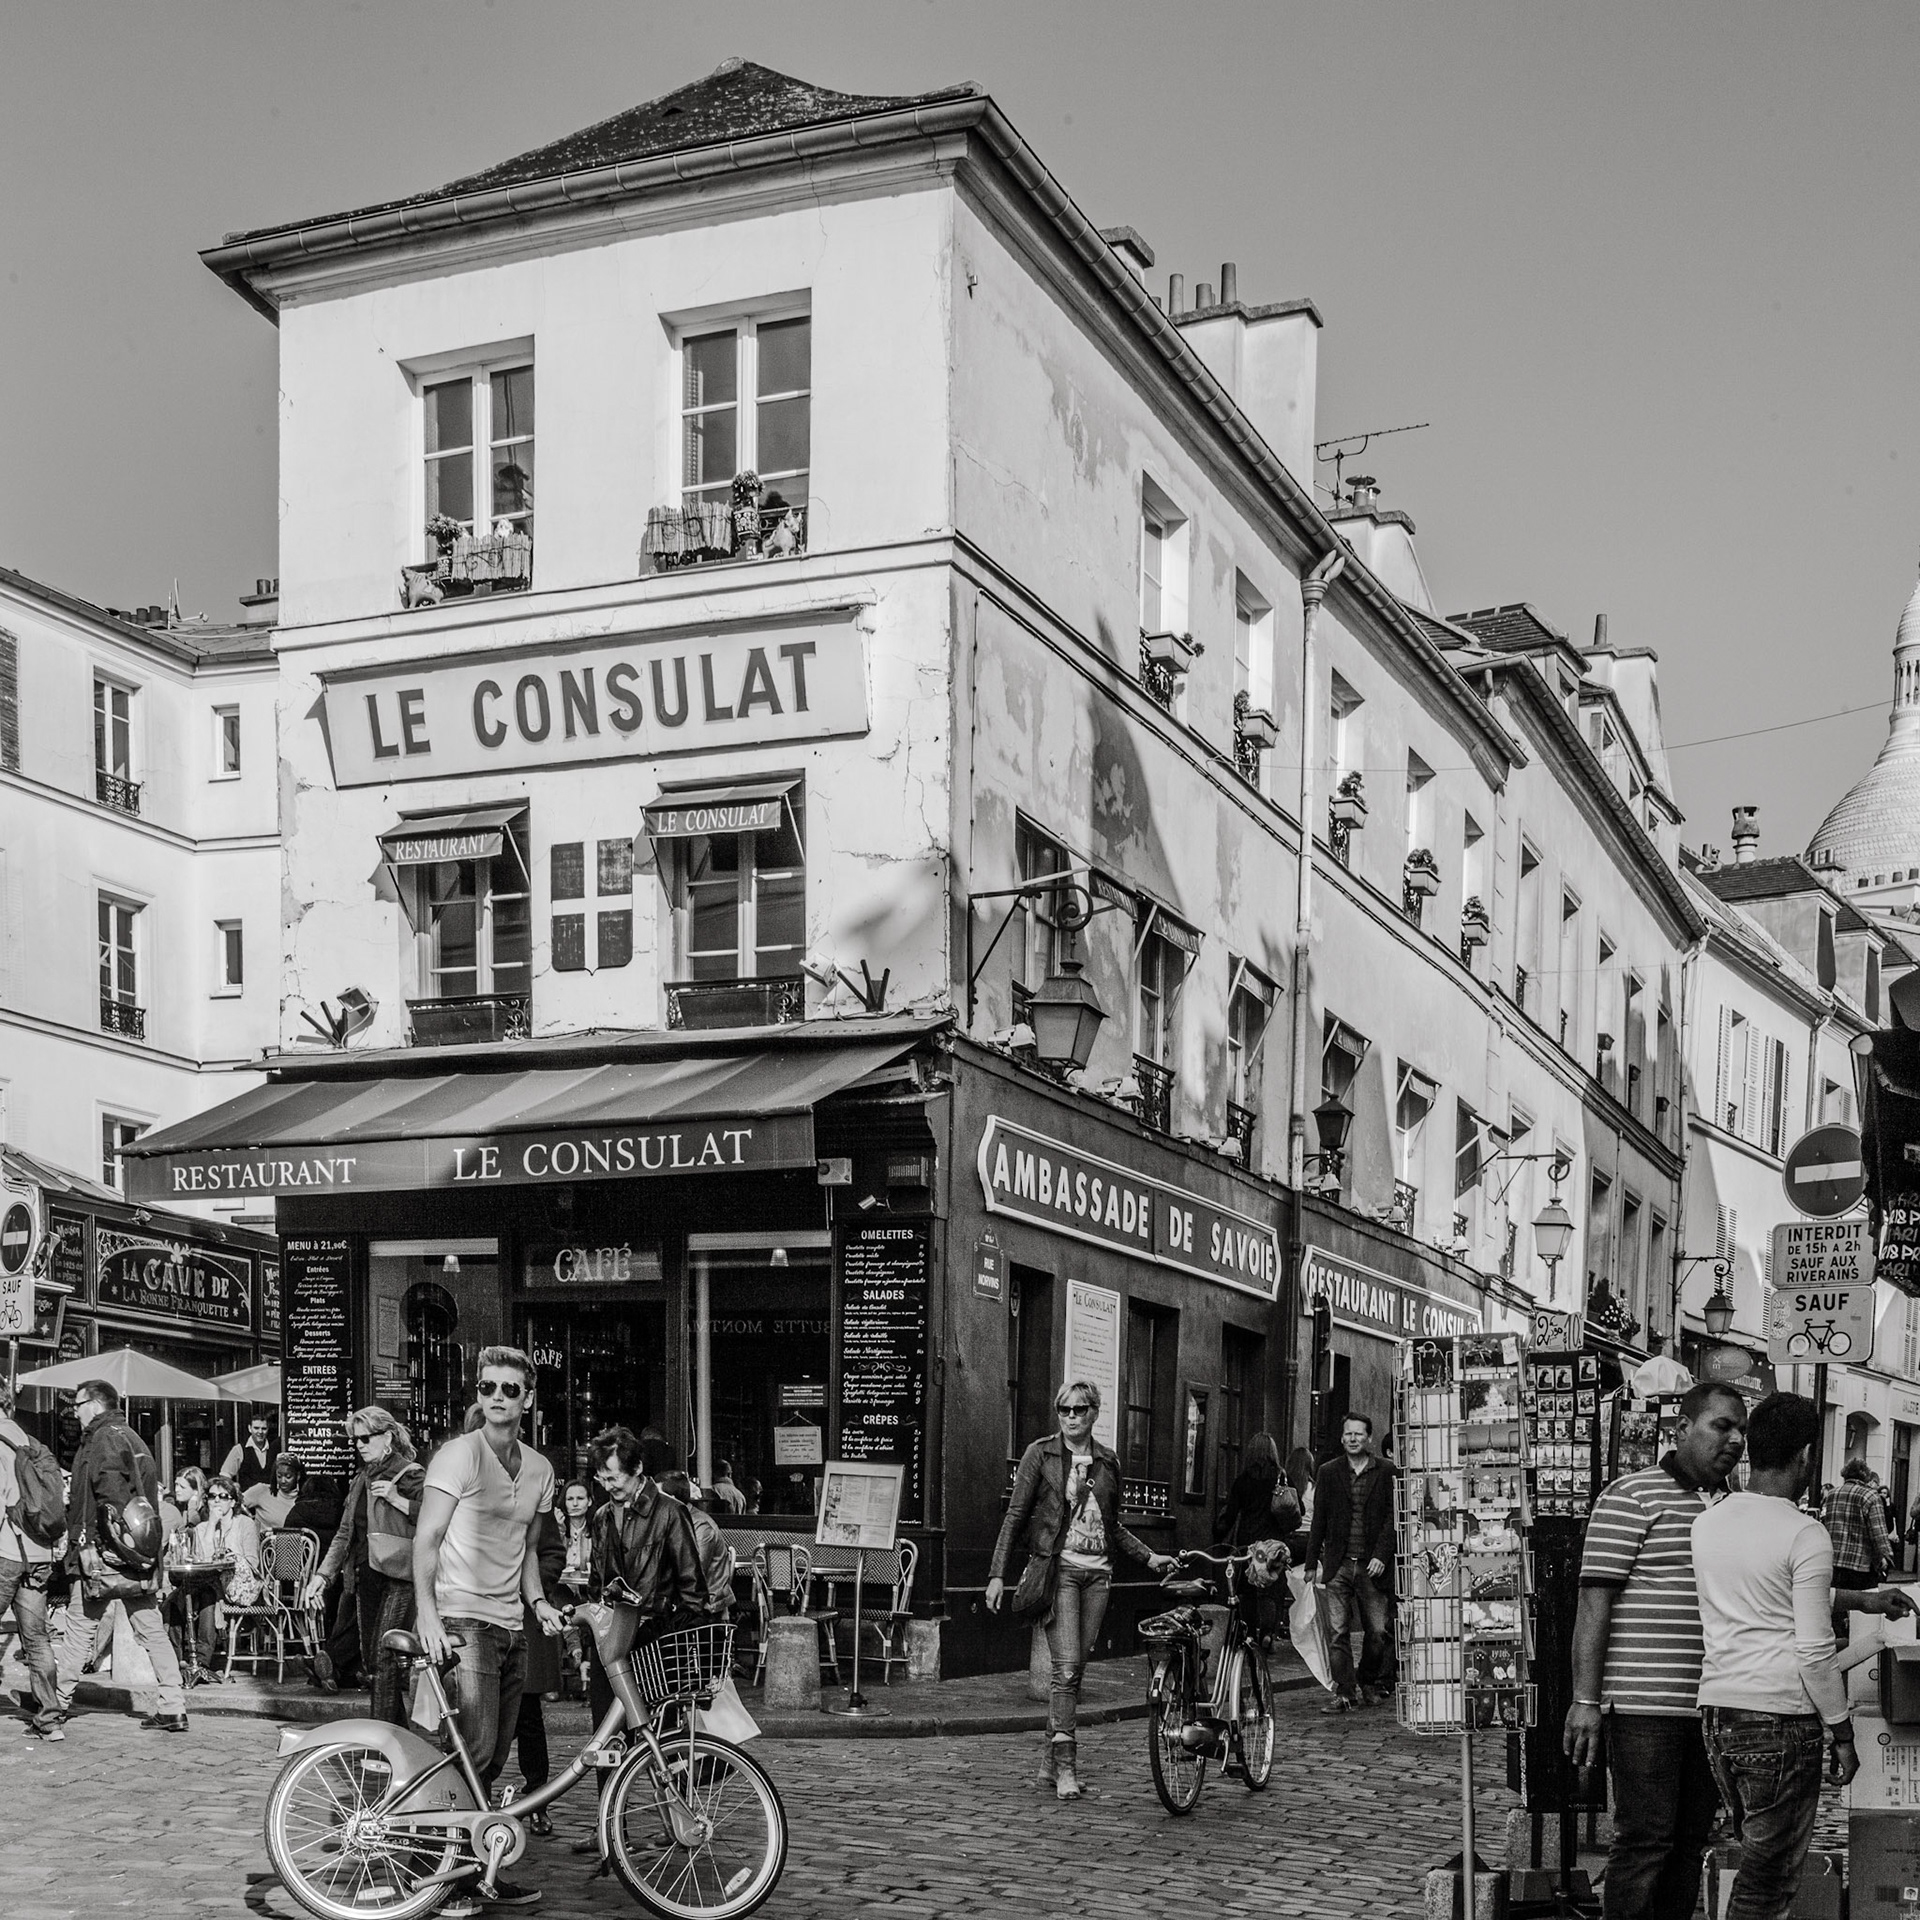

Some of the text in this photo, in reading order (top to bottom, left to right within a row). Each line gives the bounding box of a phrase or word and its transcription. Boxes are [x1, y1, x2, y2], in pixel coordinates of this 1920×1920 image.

[366, 642, 816, 760] LE CONSULAT
[657, 802, 769, 833] LE CONSULAT
[395, 833, 488, 860] RESTAURANT
[172, 1128, 752, 1192] RESTAURANT LE CONSULAT
[992, 1142, 1274, 1283] AMBASSADE DE SAVOIE
[861, 1229, 914, 1240] OMELETTES
[1788, 1224, 1862, 1243] INTERDIT
[287, 1241, 311, 1251] MENU
[313, 1240, 319, 1250] à
[1788, 1240, 1861, 1256] DE 15h A 2h
[553, 1241, 633, 1283] CAFÉ
[983, 1257, 995, 1271] RUE
[1791, 1255, 1857, 1270] SAUF AUX
[122, 1258, 230, 1299] LA CAVE DE
[977, 1273, 1000, 1290] NORVINS
[1787, 1268, 1859, 1282] RIVERAINS
[2, 1280, 22, 1295] SAUF
[862, 1289, 905, 1300] SALADES
[122, 1285, 230, 1318] LA BONNE FRANQUETTE
[1309, 1262, 1396, 1325] RESTAURANT
[1403, 1297, 1416, 1332] LE
[1795, 1292, 1850, 1312] SAUF
[304, 1330, 331, 1338] Desserts
[533, 1348, 563, 1369] CAFÉ
[303, 1364, 337, 1375] ENTRÉES
[863, 1413, 899, 1425] CRÊPES
[308, 1427, 332, 1438] PLATS
